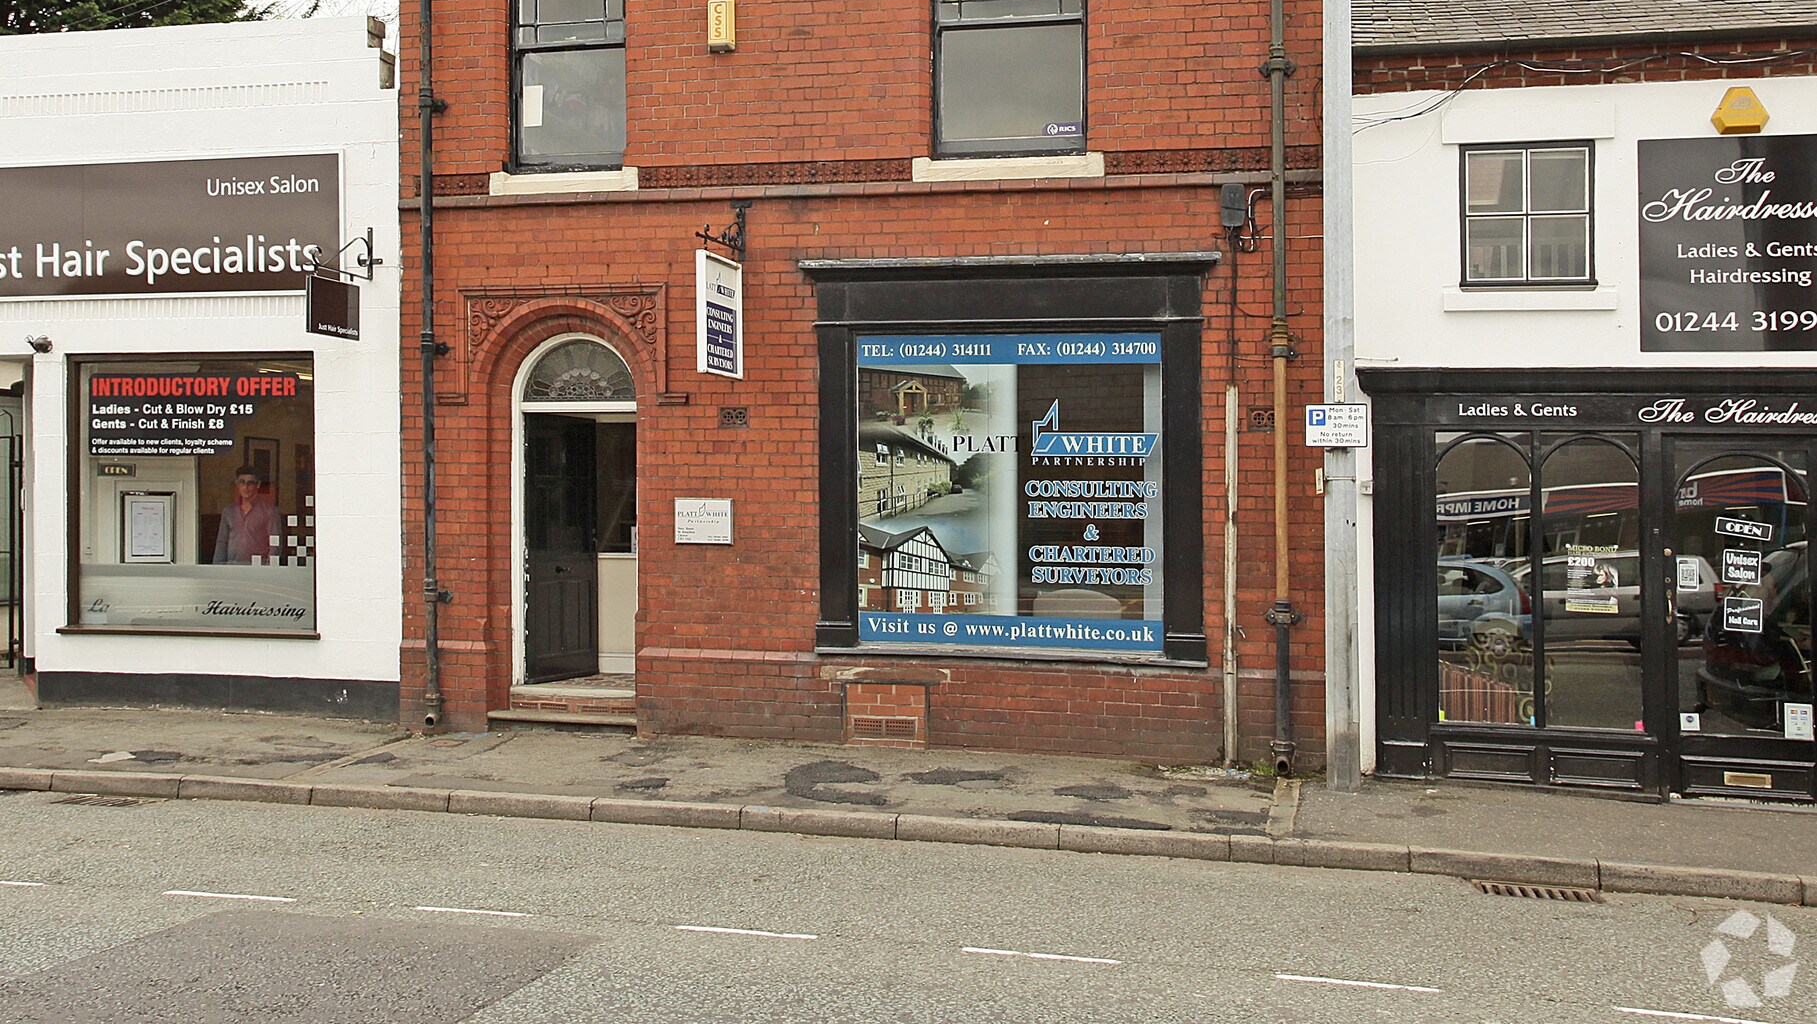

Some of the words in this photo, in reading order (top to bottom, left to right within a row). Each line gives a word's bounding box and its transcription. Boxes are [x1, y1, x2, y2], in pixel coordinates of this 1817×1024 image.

[714, 4, 722, 38] CSS
[1714, 157, 1776, 184] The
[206, 176, 265, 196] Unisex
[269, 174, 319, 194] Salon
[1677, 243, 1738, 258] Ladies
[1744, 242, 1762, 257] &
[36, 240, 110, 278] Hair
[125, 234, 319, 285] Specialists
[1689, 268, 1812, 287] Hairdressing
[707, 306, 734, 323] CONSULTING
[1655, 311, 1739, 332] 01244
[327, 324, 337, 333] Hair
[337, 326, 359, 336] Specialists
[708, 318, 733, 334] ENGINEERS
[707, 343, 734, 358] CHARTERED
[861, 344, 894, 356] TEL:
[899, 342, 947, 358] (01244)
[952, 344, 992, 356] 314111
[1017, 343, 1051, 355] FAX:
[1056, 341, 1106, 356] (01244)
[1111, 342, 1156, 355] 314700
[708, 355, 733, 370] SURVEYORS
[92, 377, 231, 396] INTRODUCTORY
[236, 377, 296, 396] OFFER
[92, 404, 131, 414] Ladies
[142, 404, 163, 414] Cut
[165, 404, 174, 414] &
[176, 404, 204, 414] Blow
[206, 404, 227, 416] Dry
[229, 404, 254, 414] £15
[1458, 403, 1509, 416] Ladies
[1513, 403, 1528, 416] &
[1530, 403, 1578, 416] Gents
[1637, 398, 1695, 423] The
[92, 419, 127, 429] Gents
[138, 419, 158, 429] Cut
[160, 419, 169, 429] &
[171, 419, 205, 429] Finish
[208, 419, 225, 429] £8
[92, 438, 108, 446] Offer
[160, 438, 184, 446] clients,
[184, 438, 206, 447] loyalty
[207, 438, 233, 446] scheme
[952, 435, 1019, 453] PLATT
[1061, 435, 1148, 453] WHITE
[169, 447, 192, 455] regular
[1031, 457, 1147, 466] PARTNERSHIP
[1024, 479, 1158, 498] CONSULTING
[1028, 501, 1149, 519] ENGINEERS
[1083, 523, 1099, 541] &
[1725, 521, 1762, 537] OPEN
[1028, 545, 1156, 564] CHARTERED
[1567, 556, 1595, 567] £200
[1726, 552, 1758, 565] Unisex
[1031, 566, 1153, 585] SURVEYORS
[1727, 566, 1756, 579] Salon
[202, 600, 306, 622] Hairdressing
[868, 617, 910, 633] Visit
[917, 621, 936, 634] us
[942, 621, 958, 636] @
[965, 622, 1154, 642] www.plattwhite.co.uk
